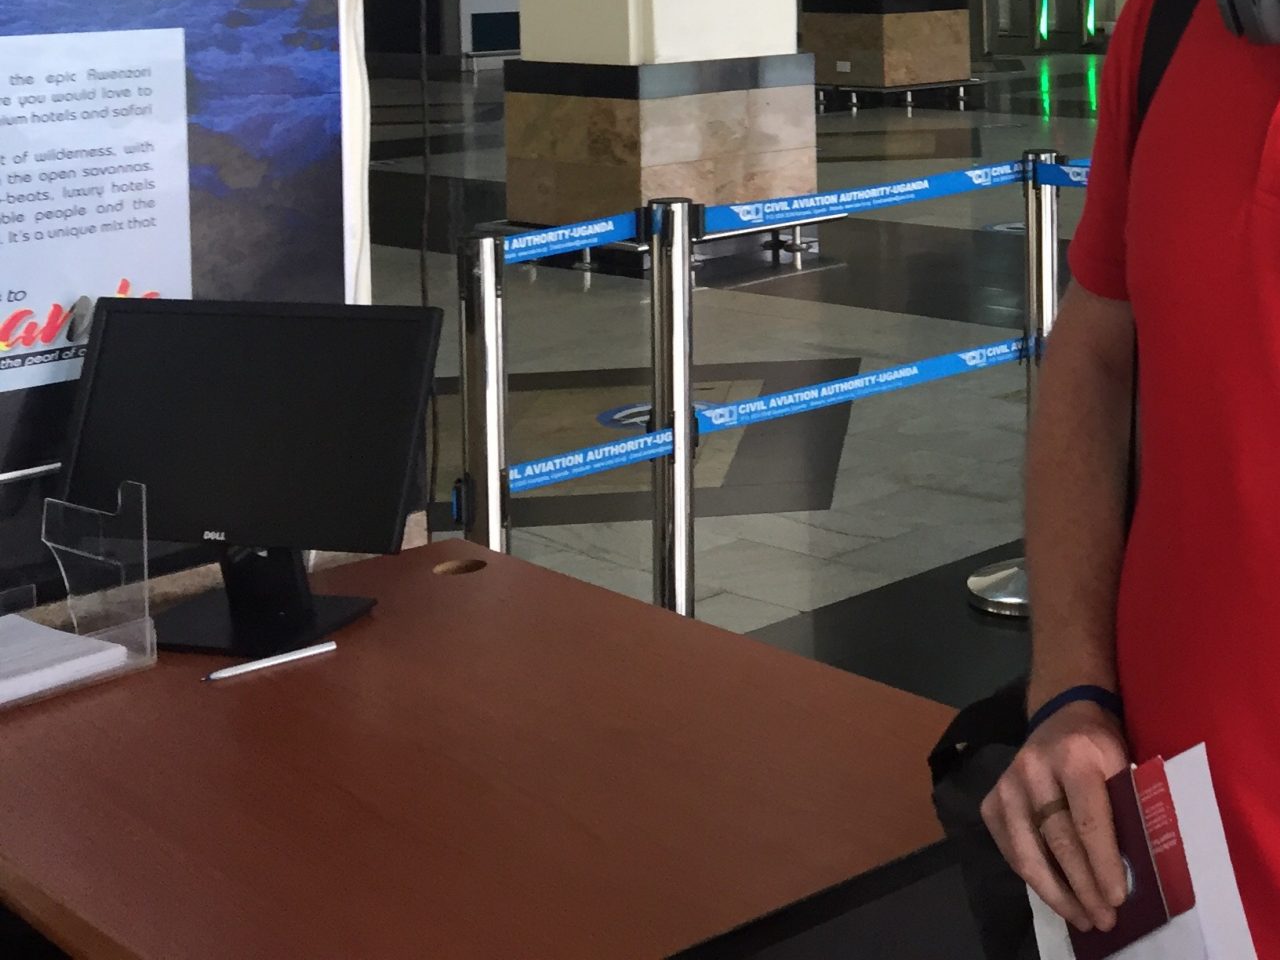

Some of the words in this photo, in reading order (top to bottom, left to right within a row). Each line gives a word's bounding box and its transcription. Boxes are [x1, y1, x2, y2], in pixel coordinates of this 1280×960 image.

[9, 74, 34, 86] the
[45, 71, 76, 87] epic
[18, 95, 46, 108] you
[51, 89, 96, 103] would
[101, 86, 131, 100] love
[137, 85, 152, 97] to
[30, 109, 77, 123] hotels
[81, 106, 109, 120] and
[112, 104, 152, 118] safari
[13, 150, 29, 165] of
[123, 141, 155, 155] with
[8, 172, 32, 184] the
[39, 169, 77, 184] open
[991, 165, 1013, 176] CIVIL
[63, 186, 104, 198] luxury
[111, 179, 155, 194] hotels
[764, 202, 790, 214] CIVIL
[791, 194, 838, 209] AVIATION
[839, 179, 930, 203] AUTHORITY-UGANDA
[0, 210, 25, 225] ble
[35, 205, 86, 224] people
[96, 200, 124, 214] and
[133, 198, 155, 210] the
[9, 229, 31, 243] It's
[34, 231, 44, 240] a
[47, 225, 97, 240] unique
[100, 220, 124, 232] mix
[127, 217, 157, 230] that
[511, 220, 615, 250] AUTHORITY-UGANDA
[7, 289, 28, 303] to
[0, 357, 22, 369] the
[24, 351, 60, 367] pearl
[61, 347, 77, 359] of
[986, 344, 1010, 357] CIVIL
[738, 401, 767, 415] CIVIL
[769, 390, 819, 409] AVIATION
[820, 366, 919, 398] AUTHORITY-UGANDA
[525, 453, 583, 477] AVIATION
[203, 530, 226, 541] DELL
